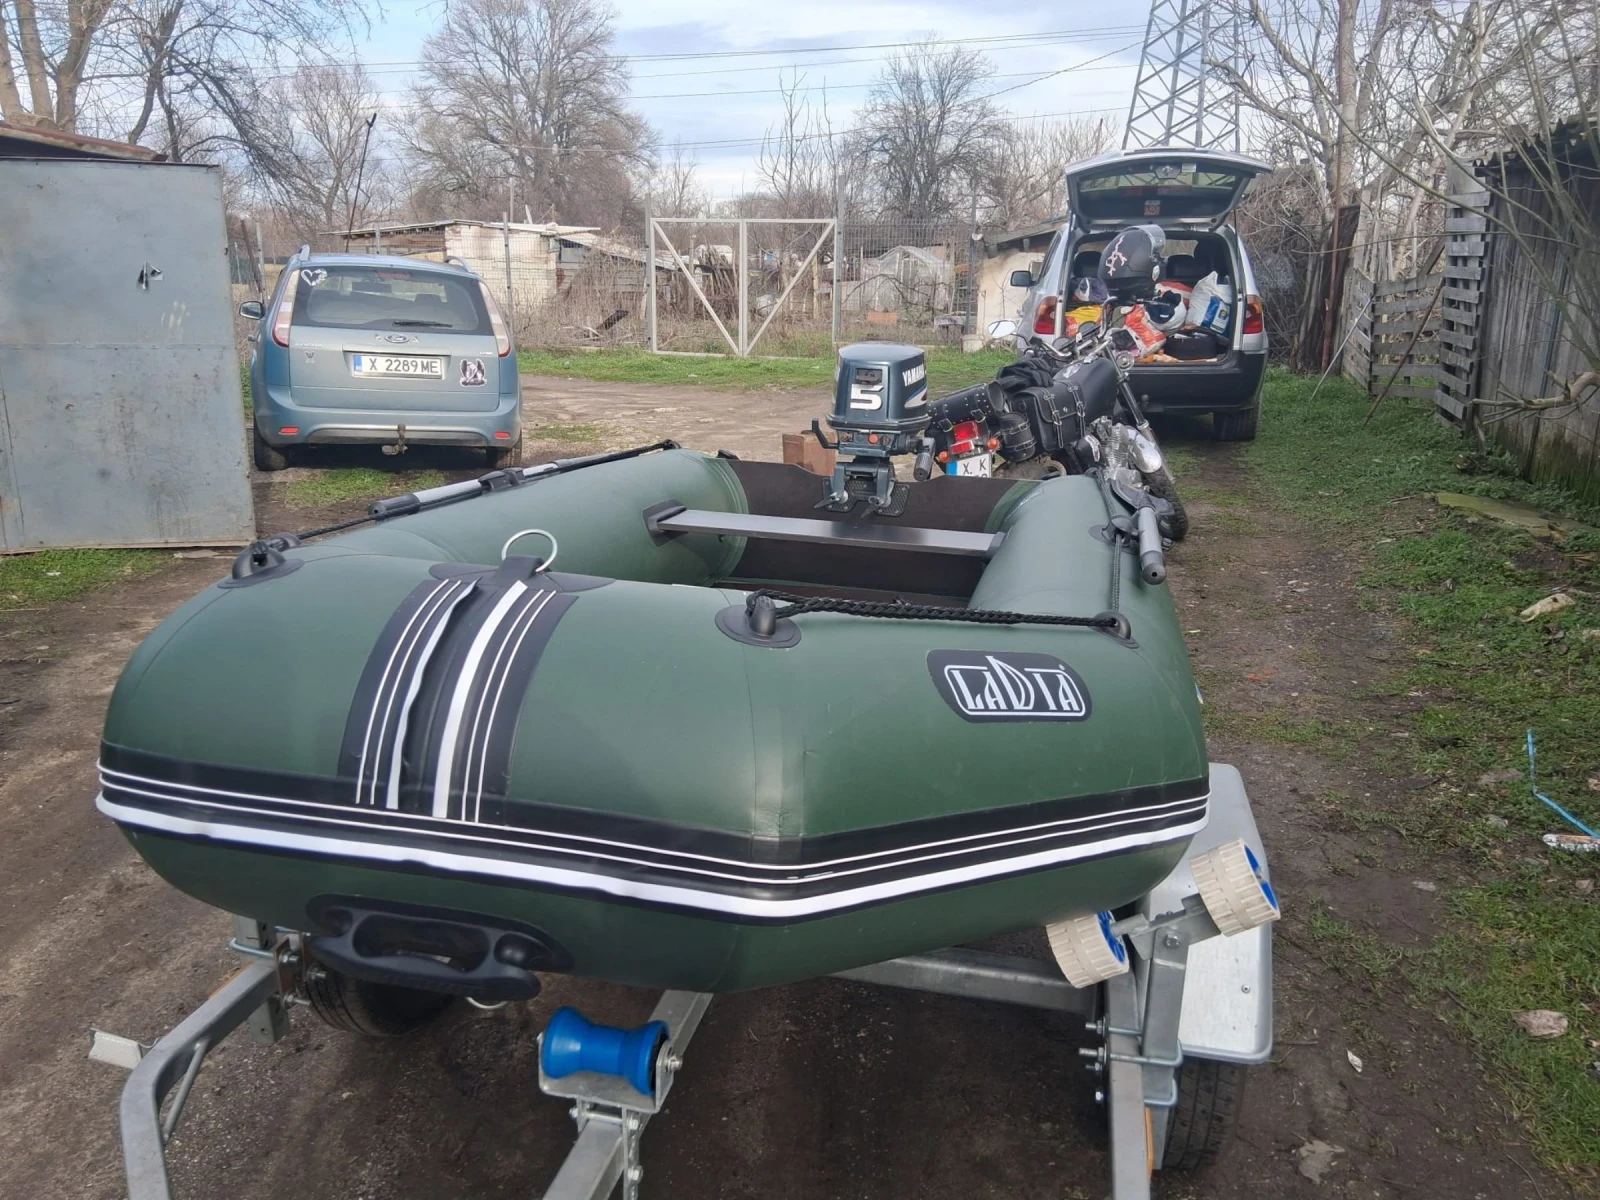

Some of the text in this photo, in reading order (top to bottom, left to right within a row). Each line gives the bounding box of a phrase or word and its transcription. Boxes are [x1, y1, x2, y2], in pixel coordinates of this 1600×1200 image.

[369, 358, 378, 371] X
[385, 359, 418, 372] 2289
[421, 360, 439, 374] ME
[850, 384, 884, 411] 5
[979, 458, 987, 471] K
[950, 656, 1081, 711] LADIA
